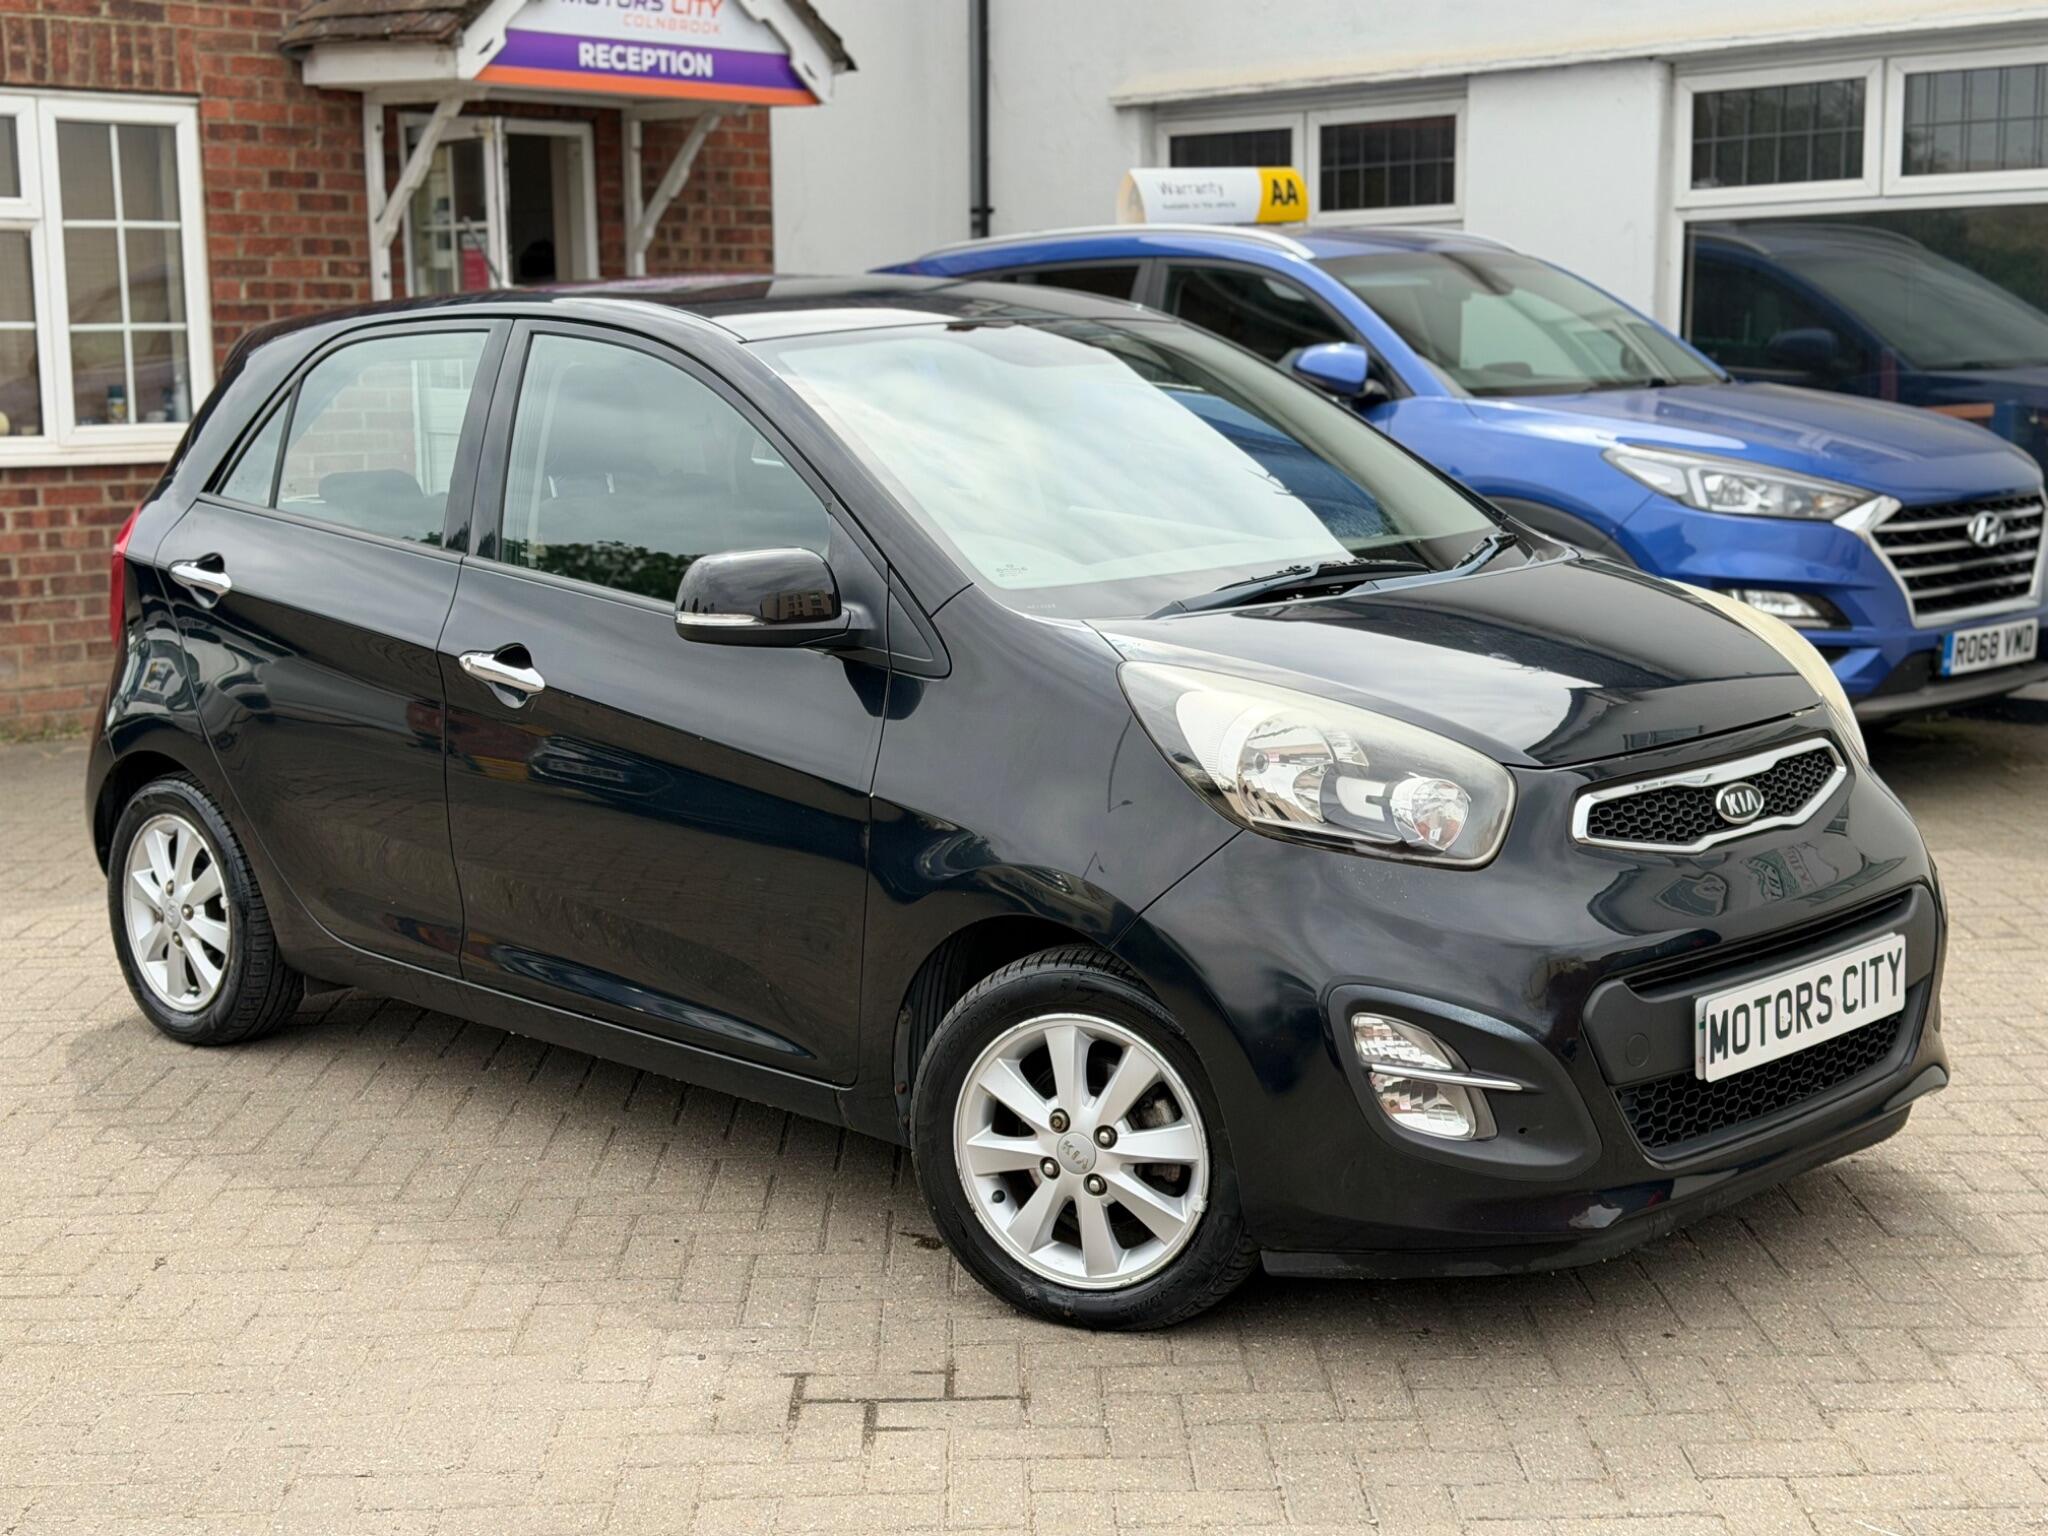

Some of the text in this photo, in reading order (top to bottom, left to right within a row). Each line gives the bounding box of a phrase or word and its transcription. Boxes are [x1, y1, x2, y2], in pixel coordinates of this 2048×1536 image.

[578, 42, 713, 77] RECEPTION
[1271, 179, 1299, 206] AA
[1955, 624, 2034, 667] RO68 VMD
[1724, 789, 1759, 816] KIA
[1709, 947, 1903, 1065] MOTORS CITY
